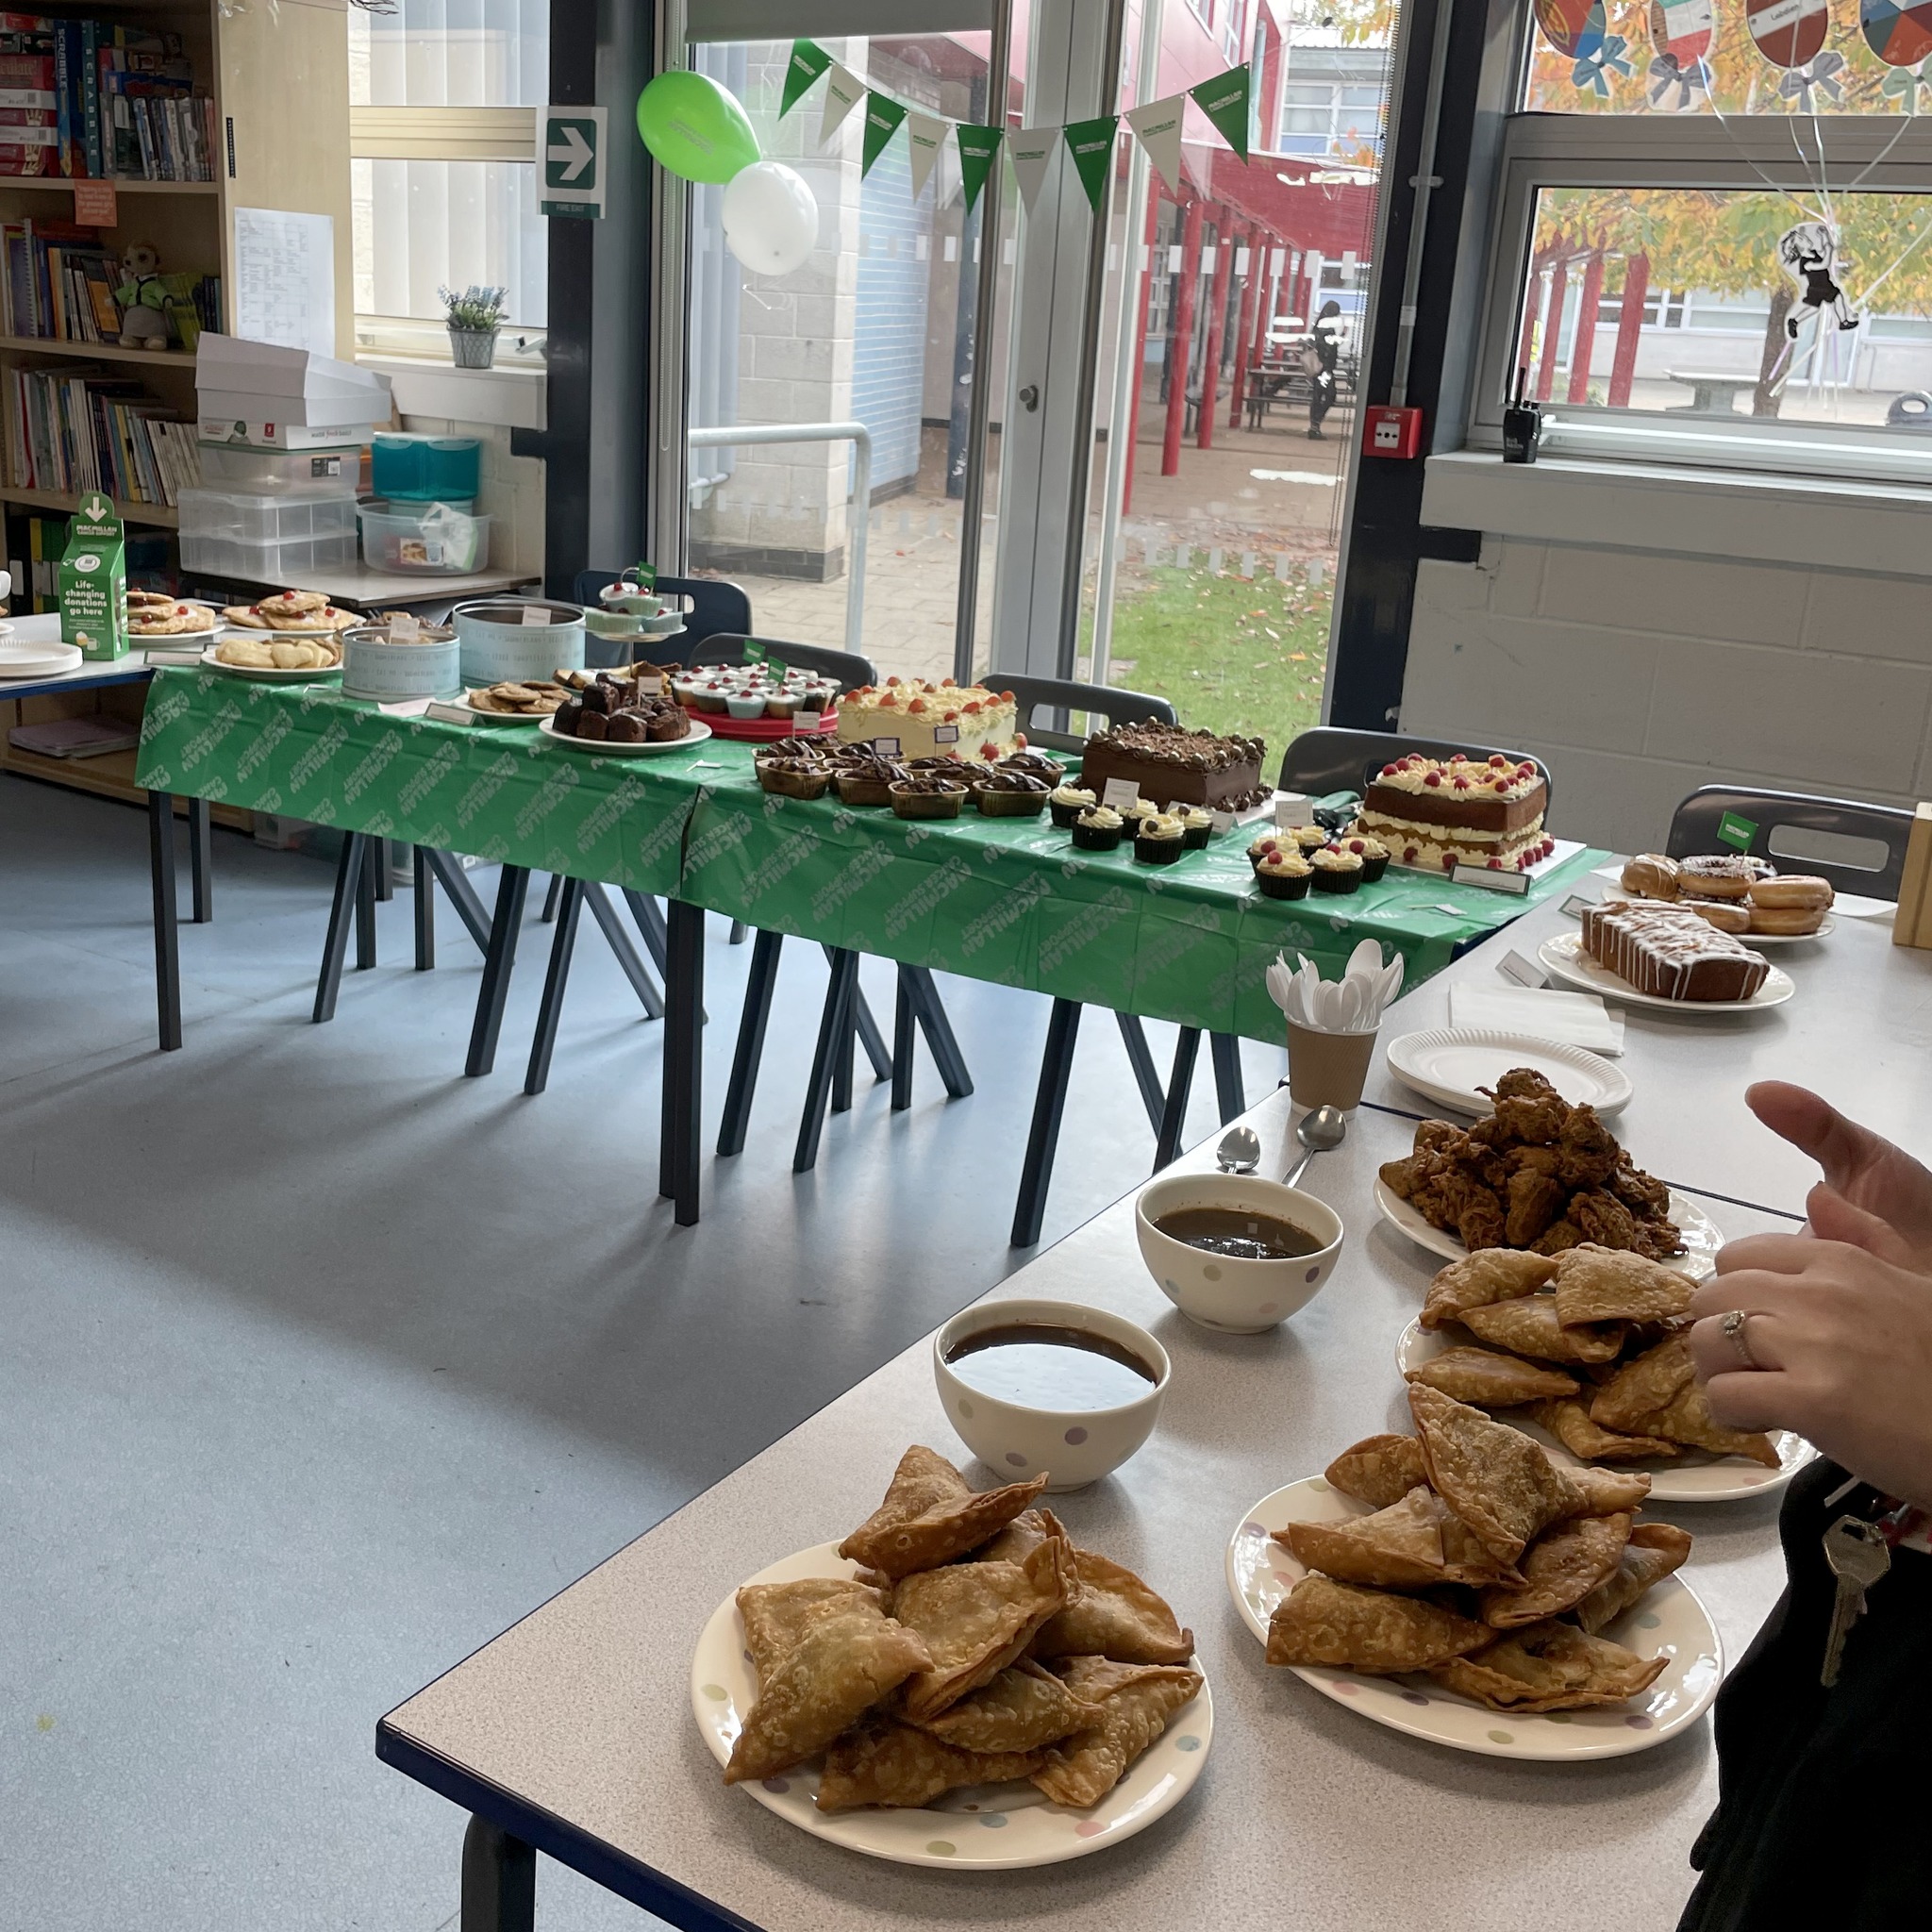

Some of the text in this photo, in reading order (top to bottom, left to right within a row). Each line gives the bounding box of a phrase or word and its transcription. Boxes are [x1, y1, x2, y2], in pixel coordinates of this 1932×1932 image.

[58, 28, 69, 89] SCRABBLE
[85, 48, 97, 157] SCRABBLE
[75, 580, 94, 589] Life-
[65, 589, 106, 600] changing
[64, 597, 108, 607] donations
[70, 607, 103, 616] go here
